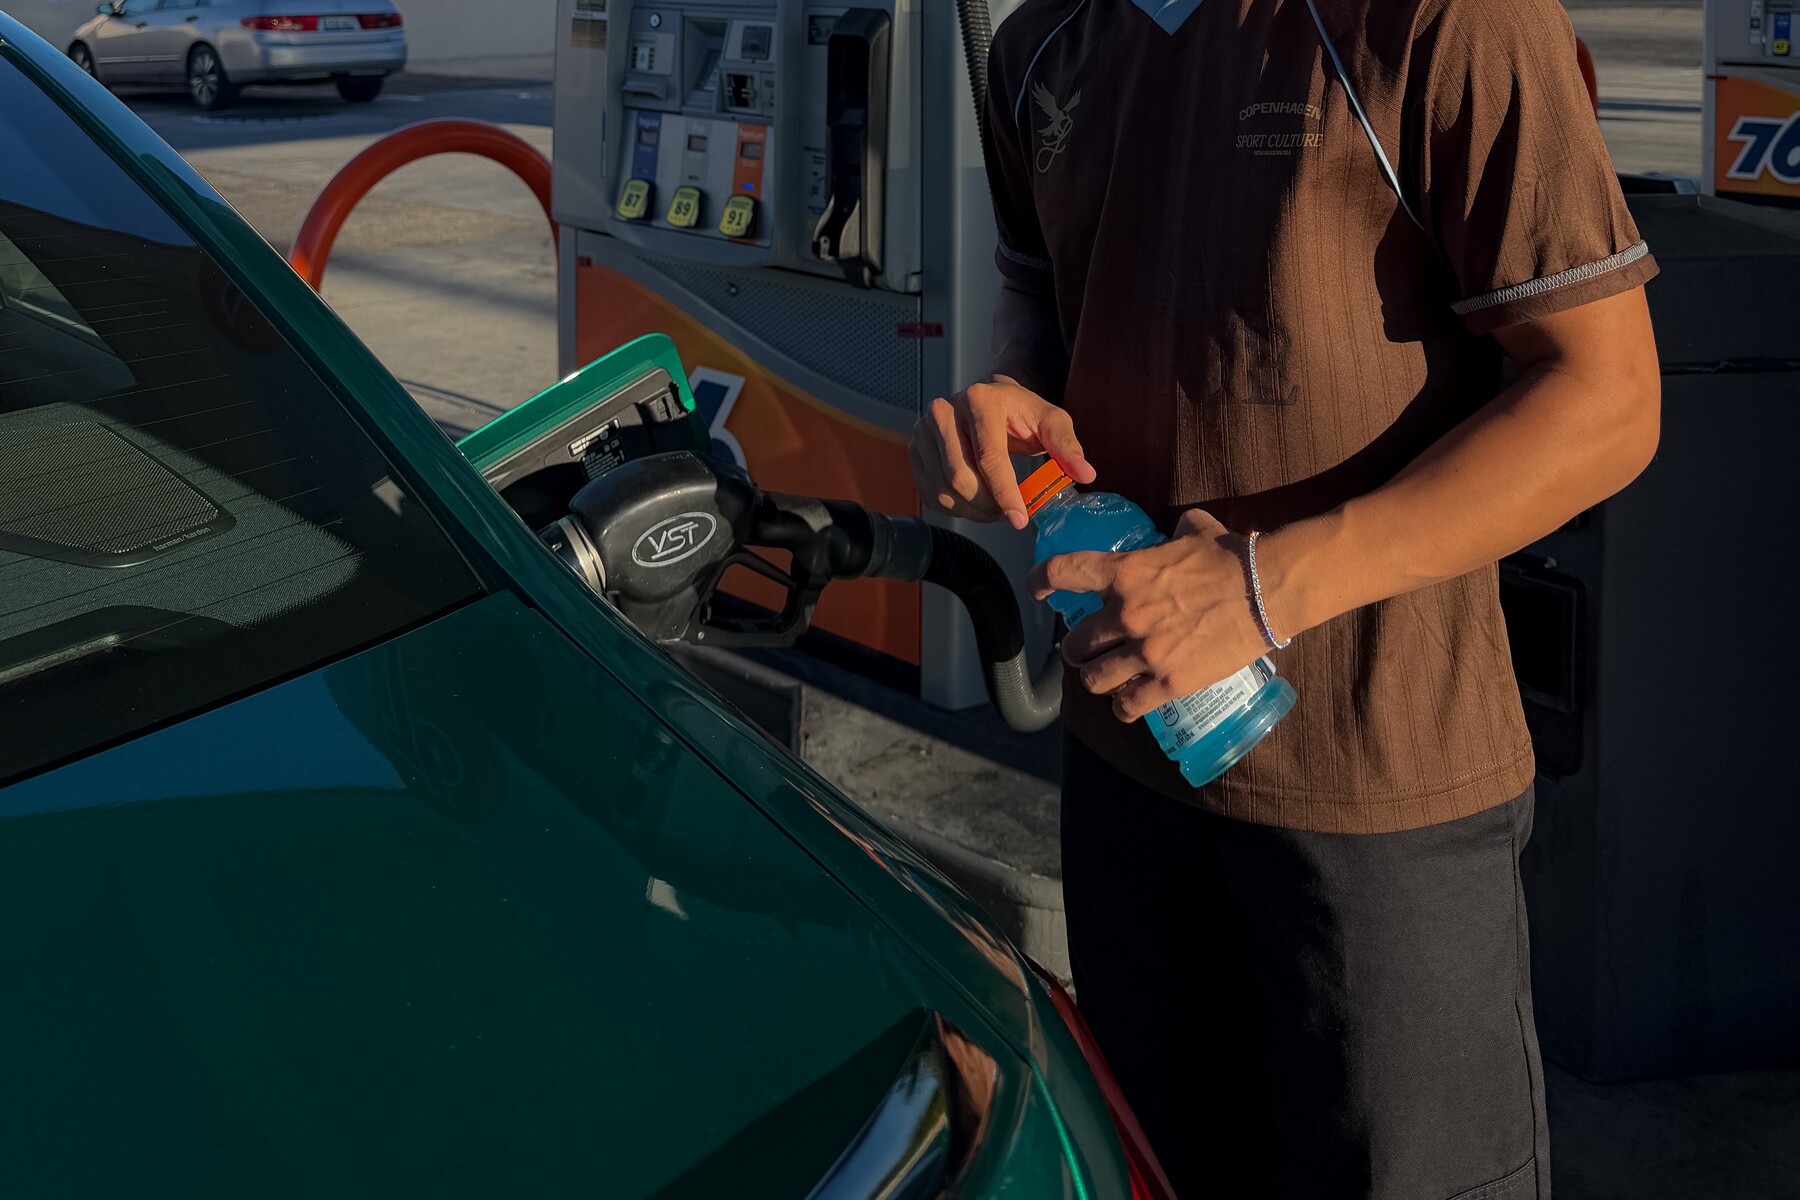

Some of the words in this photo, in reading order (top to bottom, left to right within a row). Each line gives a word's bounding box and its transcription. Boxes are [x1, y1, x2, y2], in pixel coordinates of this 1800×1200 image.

[1239, 102, 1321, 121] COPENHAGEN
[1236, 134, 1267, 148] SPORT
[1267, 133, 1324, 148] CULTURE
[624, 193, 641, 209] 87
[674, 200, 691, 216] 89
[728, 210, 743, 227] 91
[153, 527, 211, 551] harman/kardon
[648, 521, 700, 561] VST
